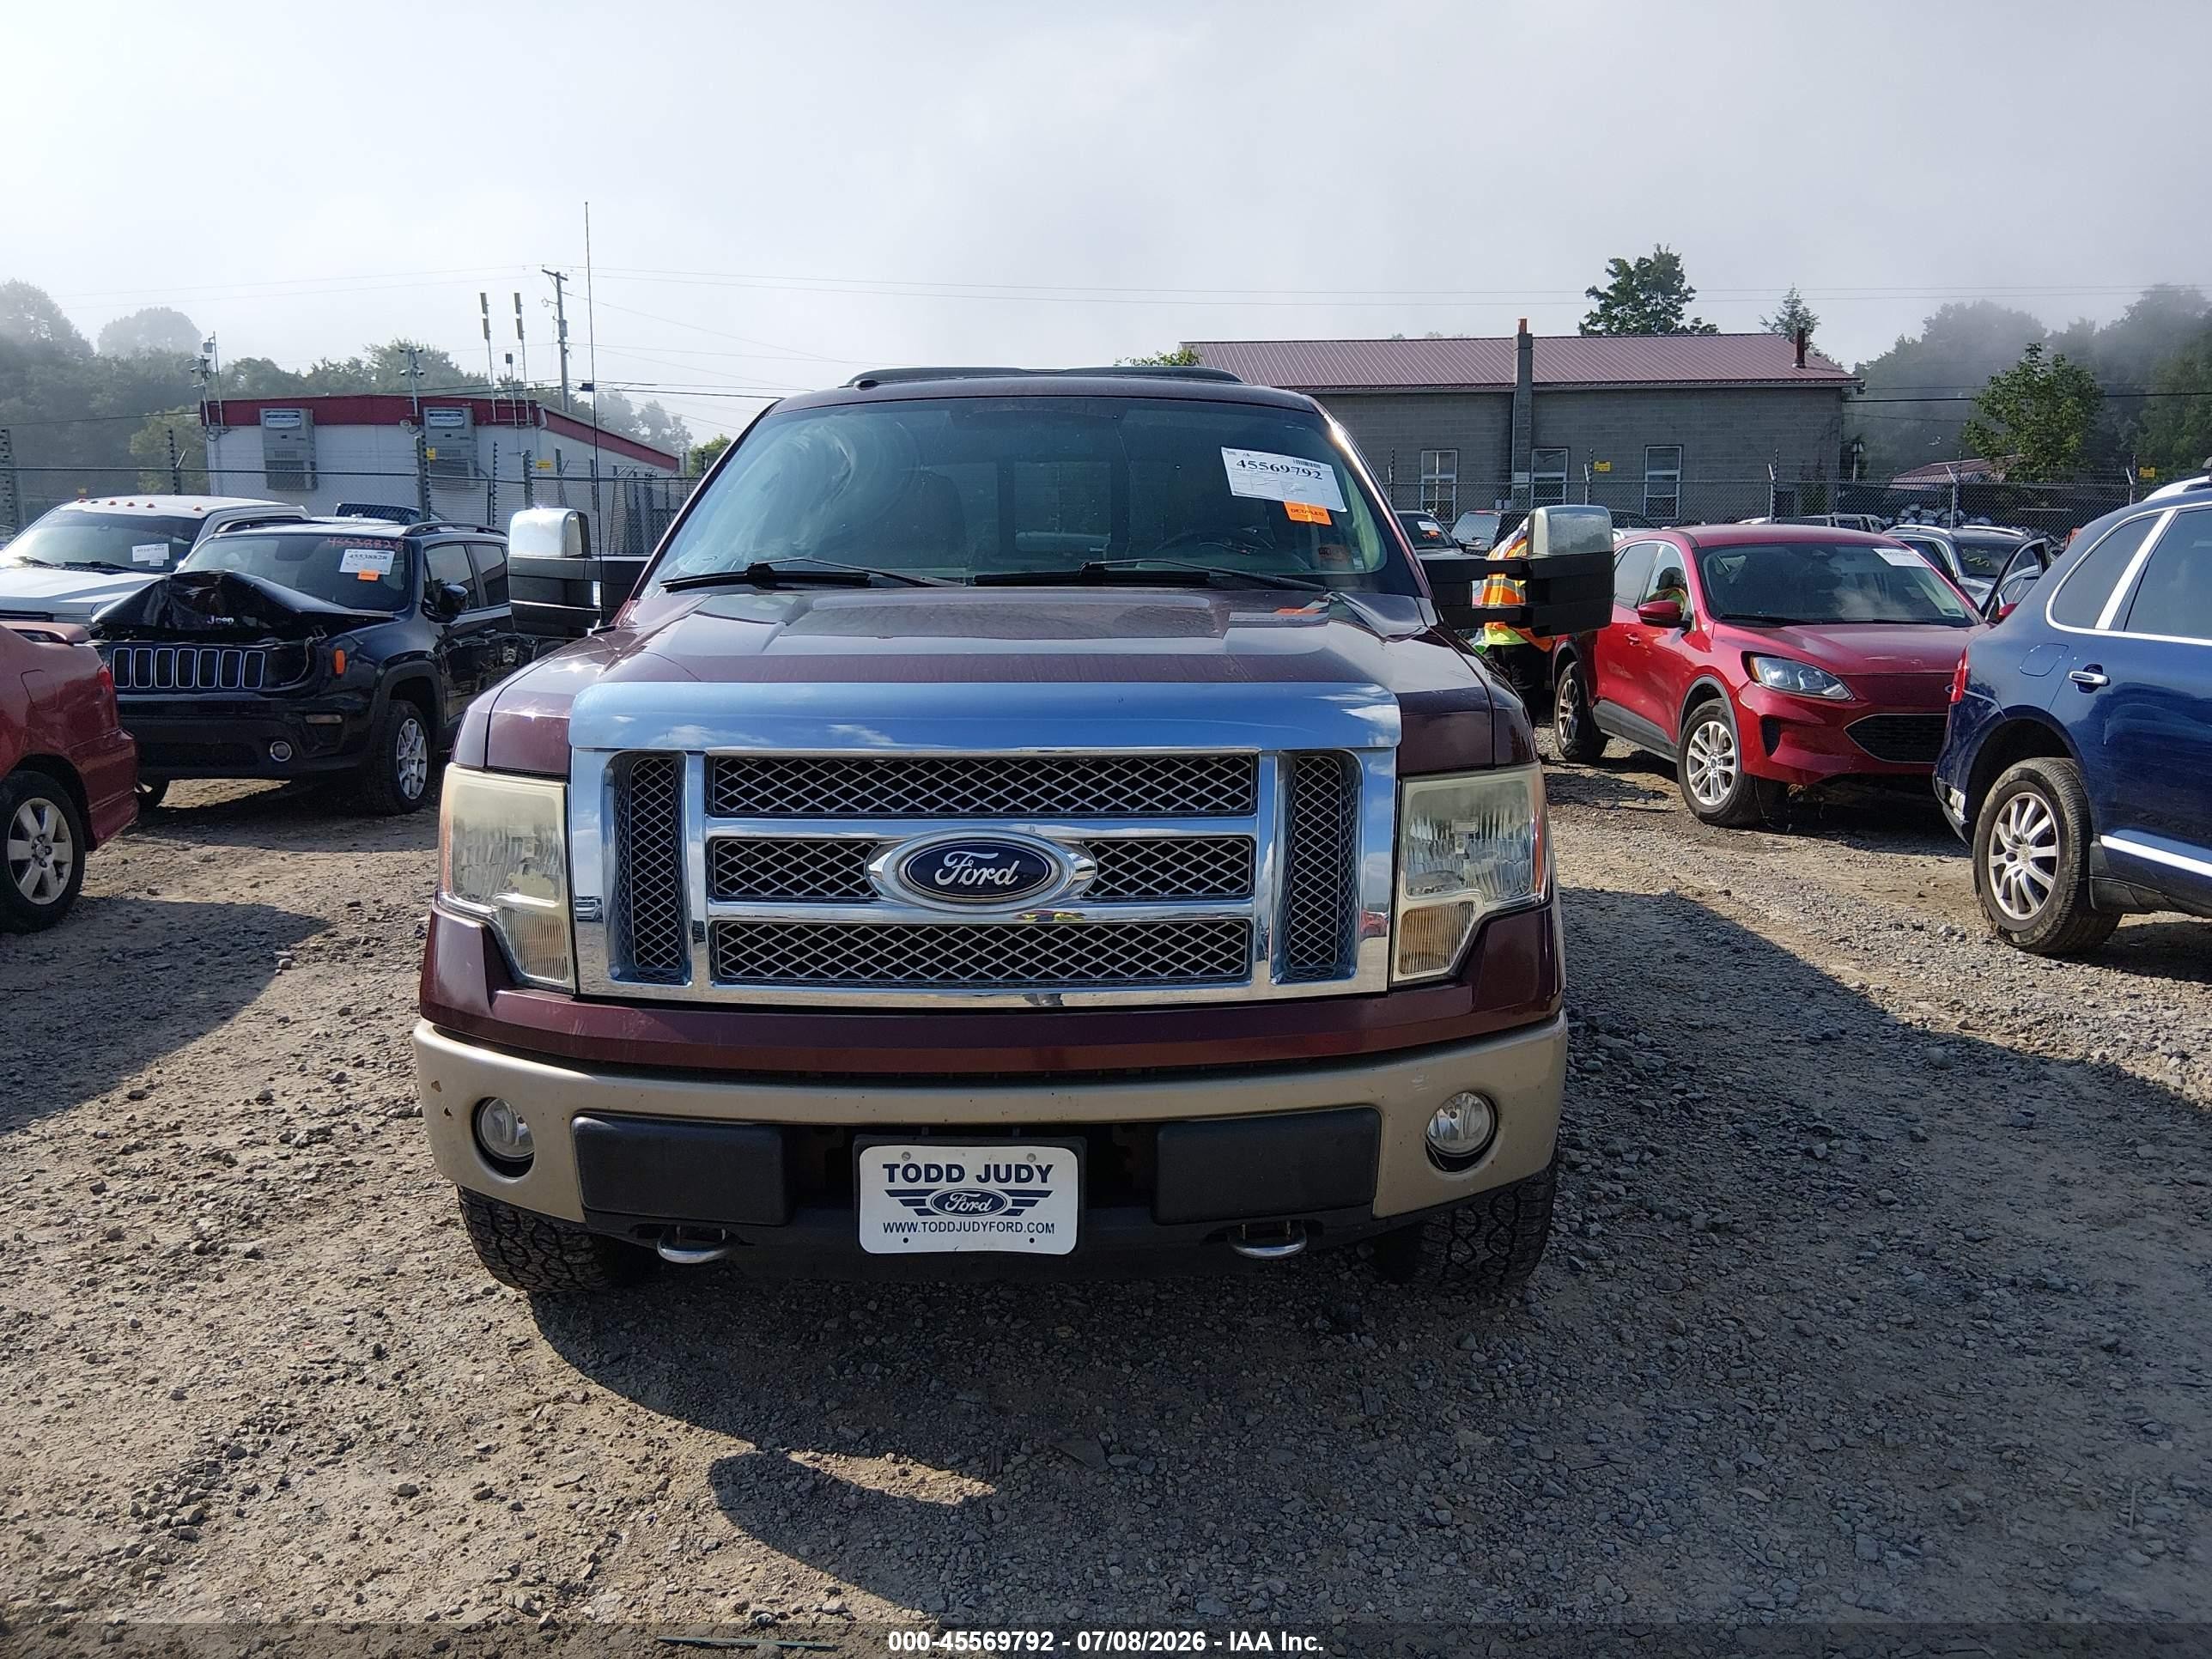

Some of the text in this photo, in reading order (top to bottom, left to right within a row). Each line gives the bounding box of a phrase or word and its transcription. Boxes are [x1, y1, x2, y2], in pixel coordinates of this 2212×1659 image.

[1236, 459, 1323, 481] 45569792
[1291, 508, 1324, 517] DETALED
[206, 615, 234, 625] Jeep
[934, 850, 1021, 886] Ford
[882, 1164, 1054, 1183] TODD JUDY
[945, 1192, 993, 1212] Ford
[883, 1221, 1055, 1235] WWW.TODDJUDYFORD.COM
